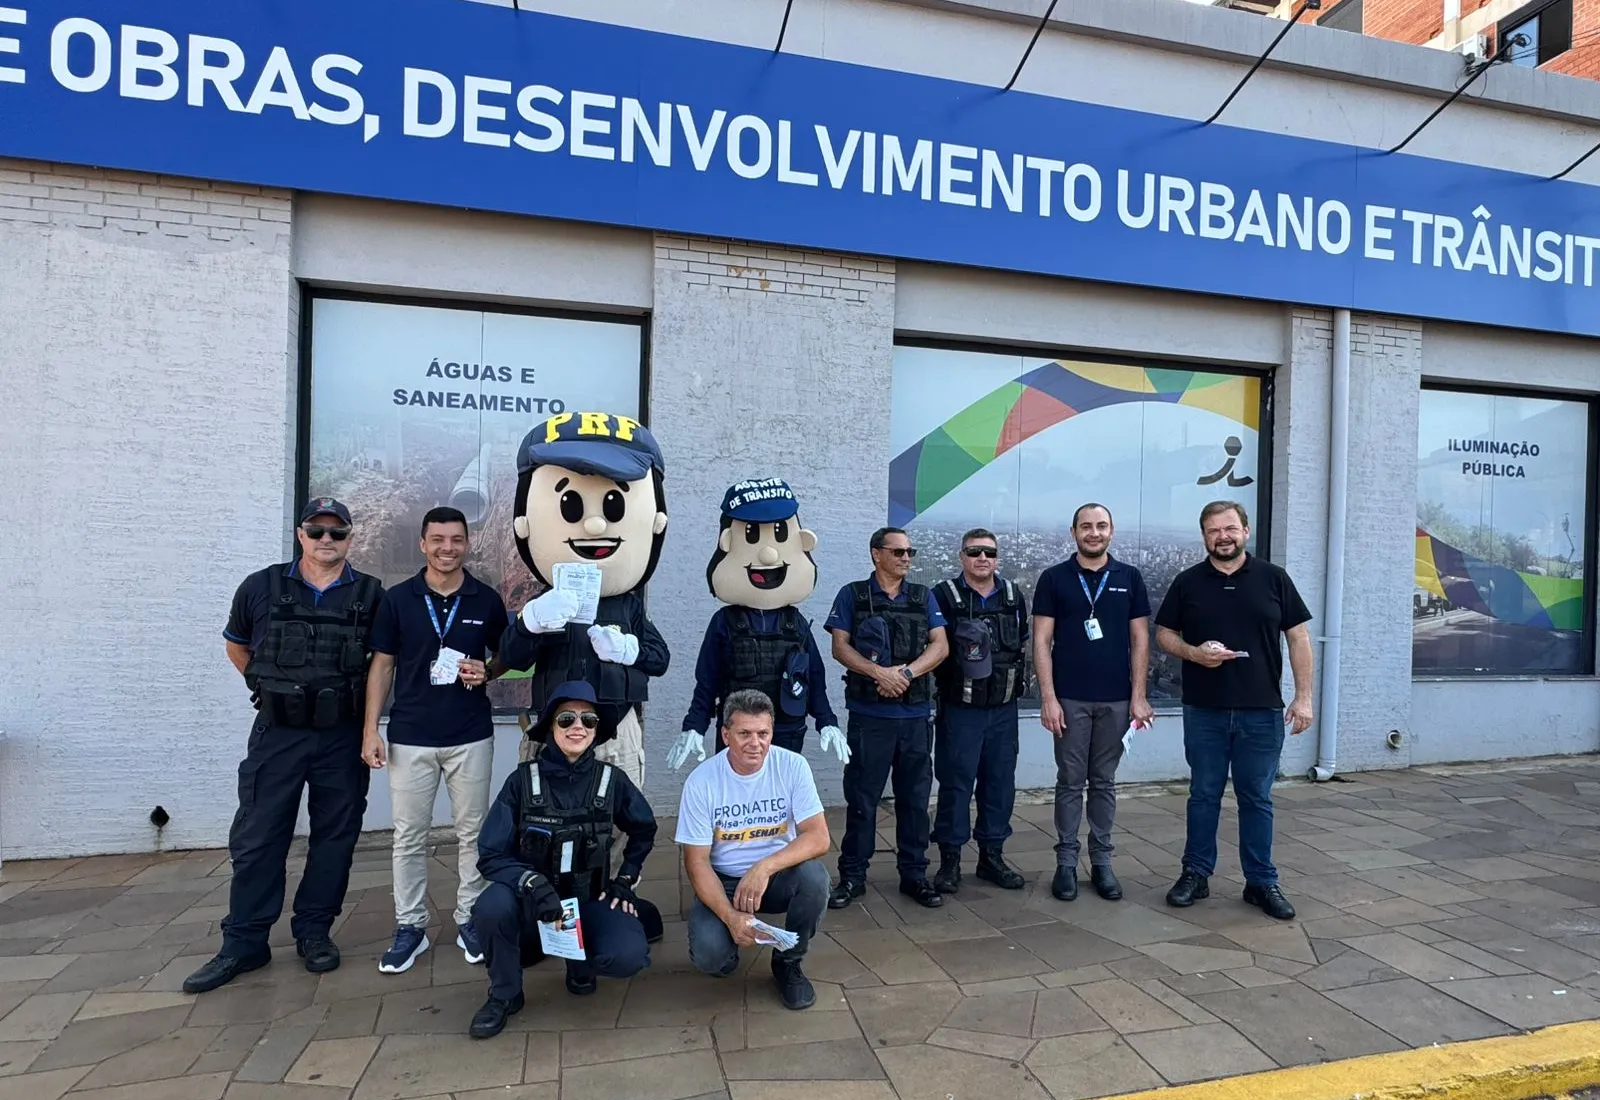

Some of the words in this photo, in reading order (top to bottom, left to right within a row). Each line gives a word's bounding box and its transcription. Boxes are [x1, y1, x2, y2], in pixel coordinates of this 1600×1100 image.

[50, 17, 380, 143] OBRAS,
[403, 66, 1102, 223] DESENVOLVIMENTO
[1117, 168, 1351, 255] URBANO
[1364, 204, 1396, 261] E
[1402, 204, 1600, 287] TRÂNSIT
[426, 357, 513, 383] ÁGUAS
[520, 368, 535, 384] E
[393, 388, 566, 415] SANEAMENTO
[545, 412, 641, 443] PRF
[1448, 438, 1540, 458] ILUMINAÇÃO
[1462, 460, 1526, 478] PÚBLICA
[735, 477, 782, 491] AGENTE
[729, 496, 741, 509] DE
[743, 488, 792, 502] TRÂNSITO
[720, 832, 746, 841] SEST
[749, 828, 780, 839] SENAT
